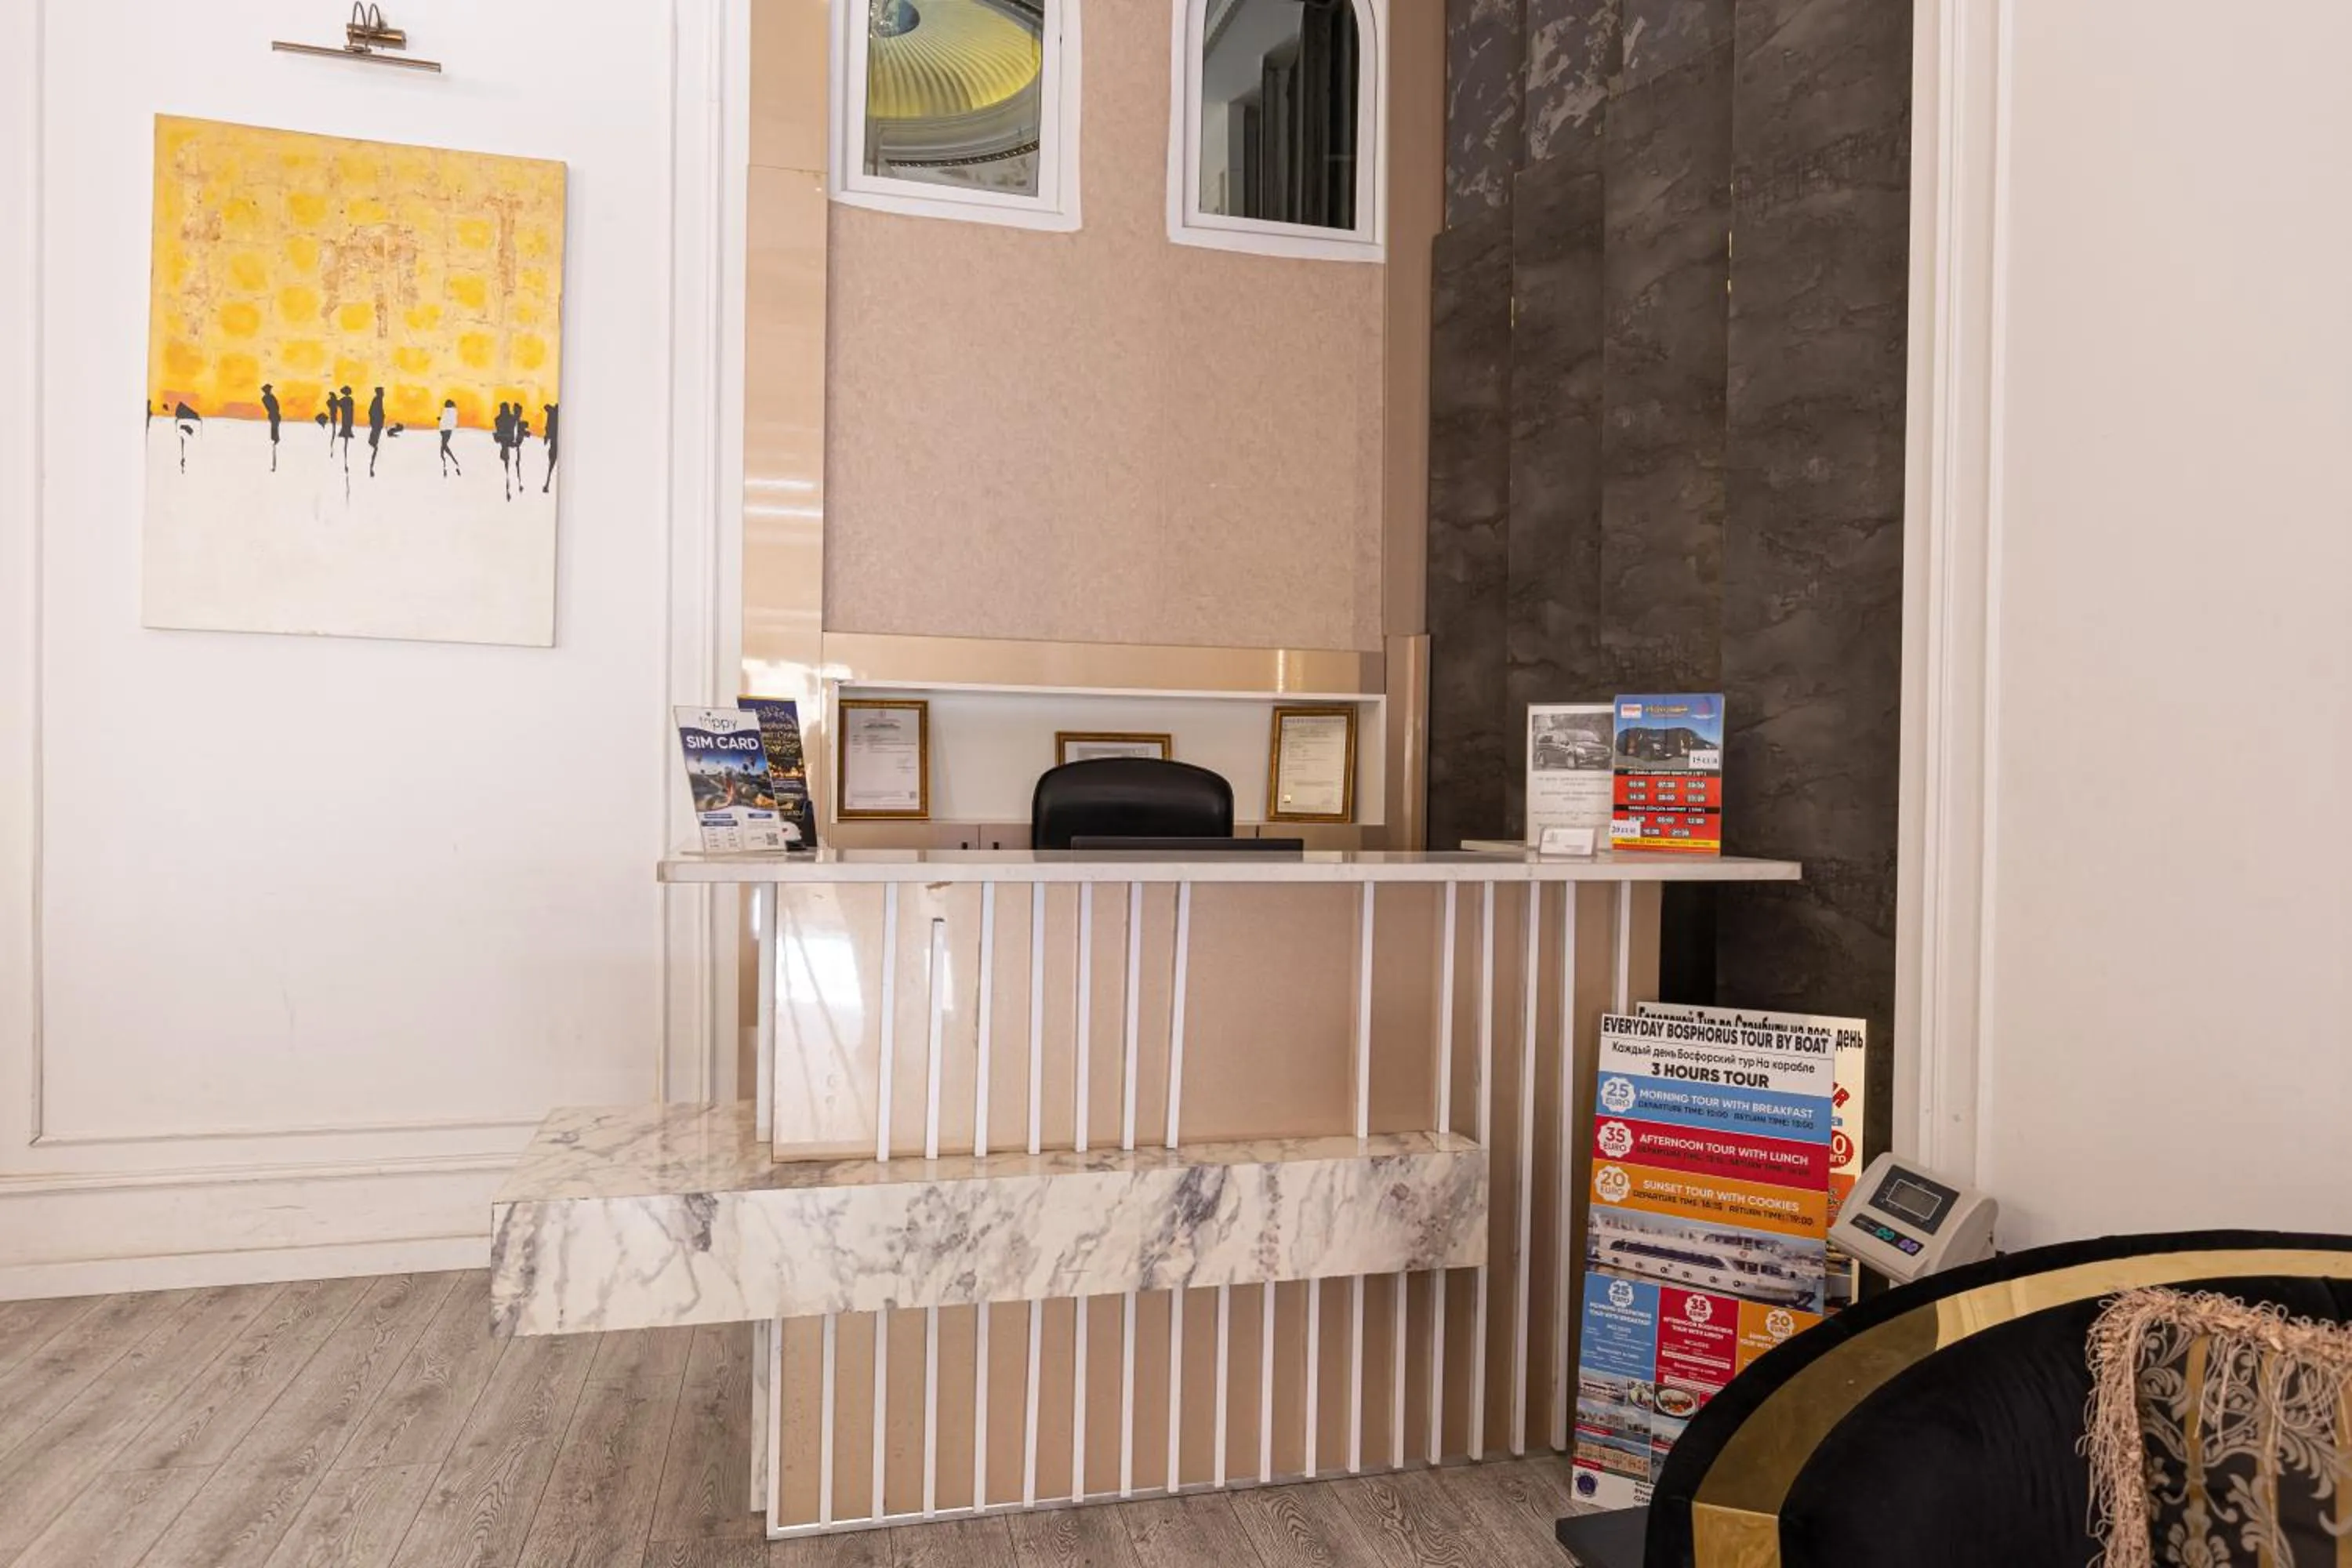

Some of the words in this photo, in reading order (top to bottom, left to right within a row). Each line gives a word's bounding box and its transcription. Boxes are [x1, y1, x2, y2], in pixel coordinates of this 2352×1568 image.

[686, 735, 714, 749] SIM
[717, 736, 759, 750] CARD
[1603, 1018, 1664, 1037] EVERYDAY
[1667, 1021, 1738, 1044] BOSPHORUS
[1740, 1029, 1773, 1048] TOUR
[1776, 1033, 1793, 1050] BY
[1795, 1036, 1829, 1054] BOAT
[1835, 1029, 1864, 1052] день
[1612, 1040, 1651, 1056] Каждый
[1652, 1047, 1677, 1058] день
[1677, 1048, 1736, 1064] Босфорский
[1738, 1058, 1755, 1069] тур
[1772, 1061, 1815, 1073] корабле
[1651, 1062, 1661, 1076] 3
[1664, 1064, 1720, 1083] HOURS
[1722, 1069, 1769, 1088] TOUR
[1607, 1081, 1629, 1098] 25
[1605, 1098, 1630, 1106] EURO
[1639, 1089, 1690, 1103] MORNING
[1691, 1095, 1719, 1108] TOUR
[1722, 1099, 1751, 1112] WITH
[1752, 1103, 1813, 1119] BREAKFAST
[1768, 1117, 1790, 1127] TIME:
[1606, 1127, 1625, 1143] 35
[1602, 1142, 1627, 1152] EURO
[1639, 1134, 1704, 1150] AFTERNOON
[1705, 1142, 1737, 1156] TOUR
[1738, 1148, 1769, 1160] WITH
[1769, 1152, 1809, 1166] LUNCH
[1600, 1171, 1626, 1186] 20
[1599, 1185, 1624, 1194] EURO
[1642, 1180, 1683, 1194] SUNSET
[1686, 1185, 1715, 1198] TOUR
[1716, 1190, 1746, 1204] WITH
[1748, 1196, 1800, 1213] COOKIES
[1633, 1189, 1677, 1203] DEPARTURE
[1729, 1205, 1762, 1217] RETURN
[1612, 1284, 1630, 1296] 25
[1690, 1298, 1707, 1311] 35
[1769, 1313, 1791, 1327] 20
